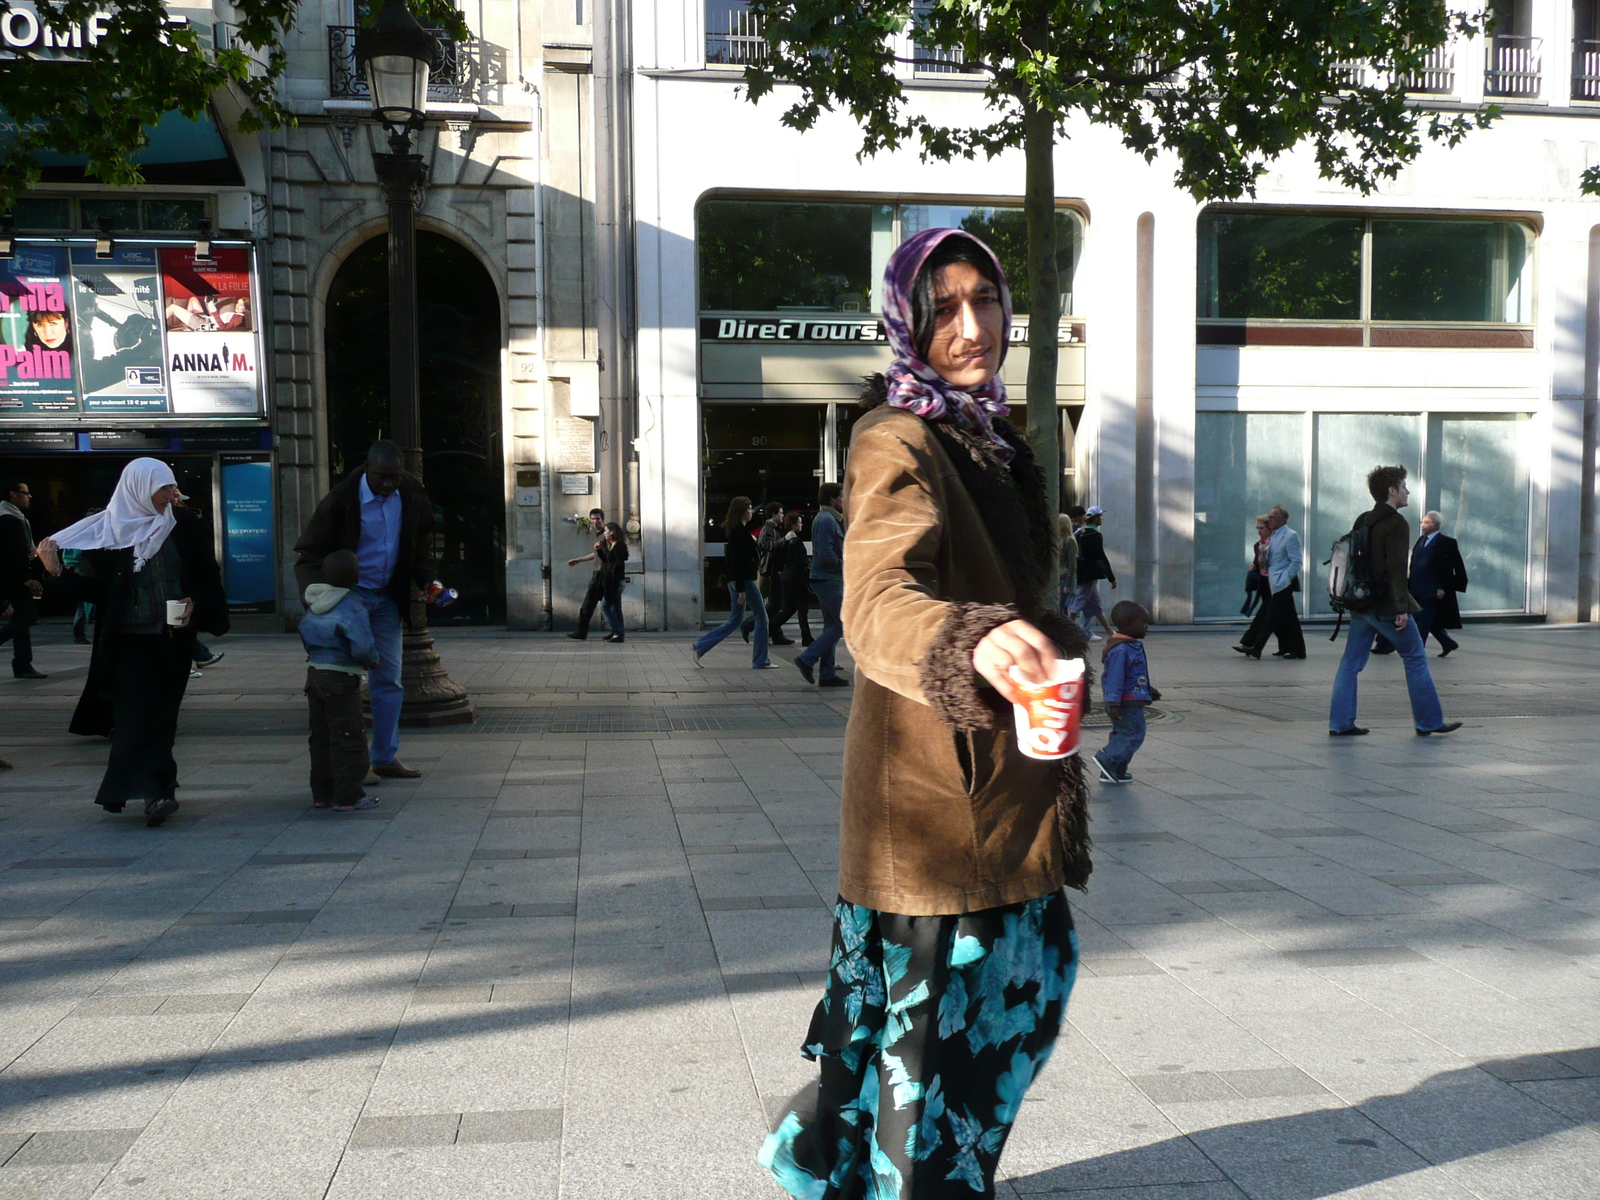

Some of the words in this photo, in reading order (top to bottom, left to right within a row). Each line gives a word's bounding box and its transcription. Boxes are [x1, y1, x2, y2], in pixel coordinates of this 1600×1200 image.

[78, 285, 87, 293] le
[218, 282, 228, 291] LA
[0, 344, 72, 379] Palm
[171, 353, 223, 372] ANNA
[232, 353, 254, 372] M.
[520, 362, 535, 373] 92
[751, 435, 768, 446] 90
